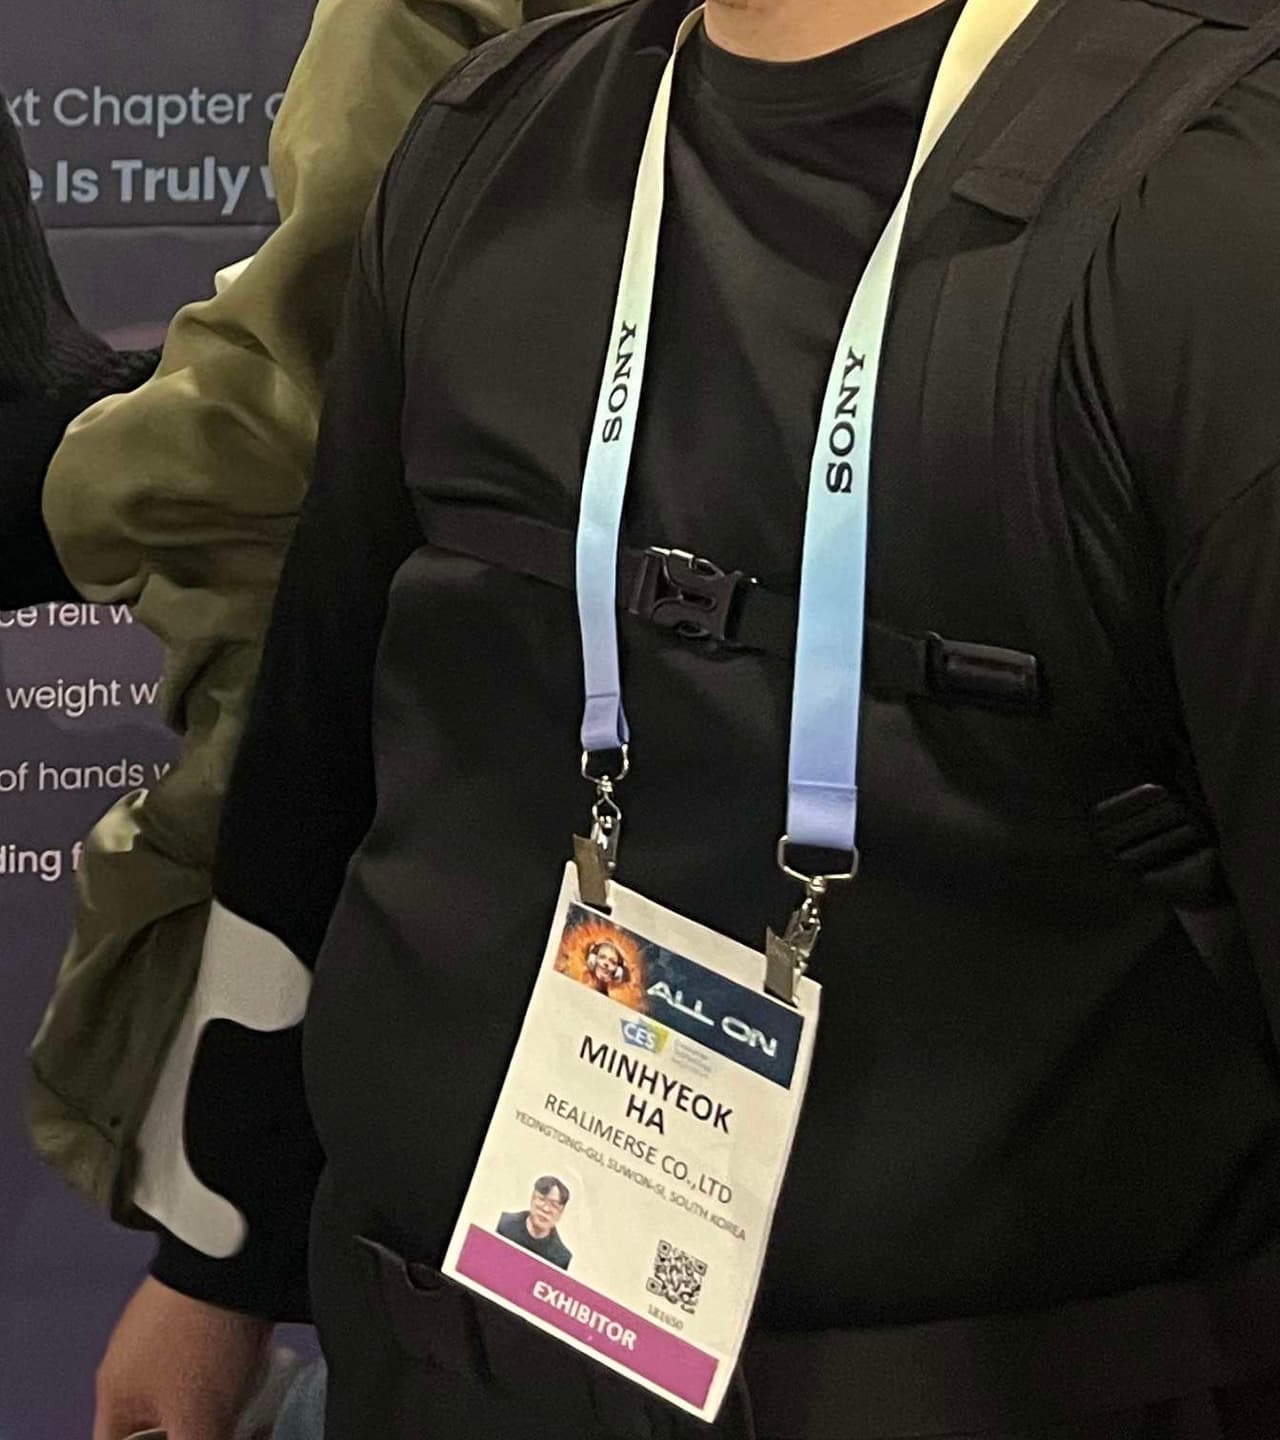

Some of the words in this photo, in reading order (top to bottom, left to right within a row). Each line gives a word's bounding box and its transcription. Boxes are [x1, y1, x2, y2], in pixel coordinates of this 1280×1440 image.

[52, 85, 252, 139] Chapter
[56, 160, 99, 203] Is
[111, 155, 250, 216] Truly
[601, 320, 637, 444] SONY
[826, 346, 866, 495] SONY
[5, 678, 121, 718] weight
[39, 758, 145, 791] hands
[622, 1022, 657, 1050] CES
[646, 980, 716, 1026] ALL
[720, 1015, 779, 1058] ON
[578, 1034, 734, 1135] MINHYEOK
[625, 1093, 666, 1136] HA
[543, 1092, 659, 1166] REALIMERSE
[661, 1154, 733, 1205] CO.,LTD
[669, 1189, 710, 1219] SOUTH
[709, 1209, 748, 1242] KOREA
[531, 1279, 639, 1352] EXHIBITOR
